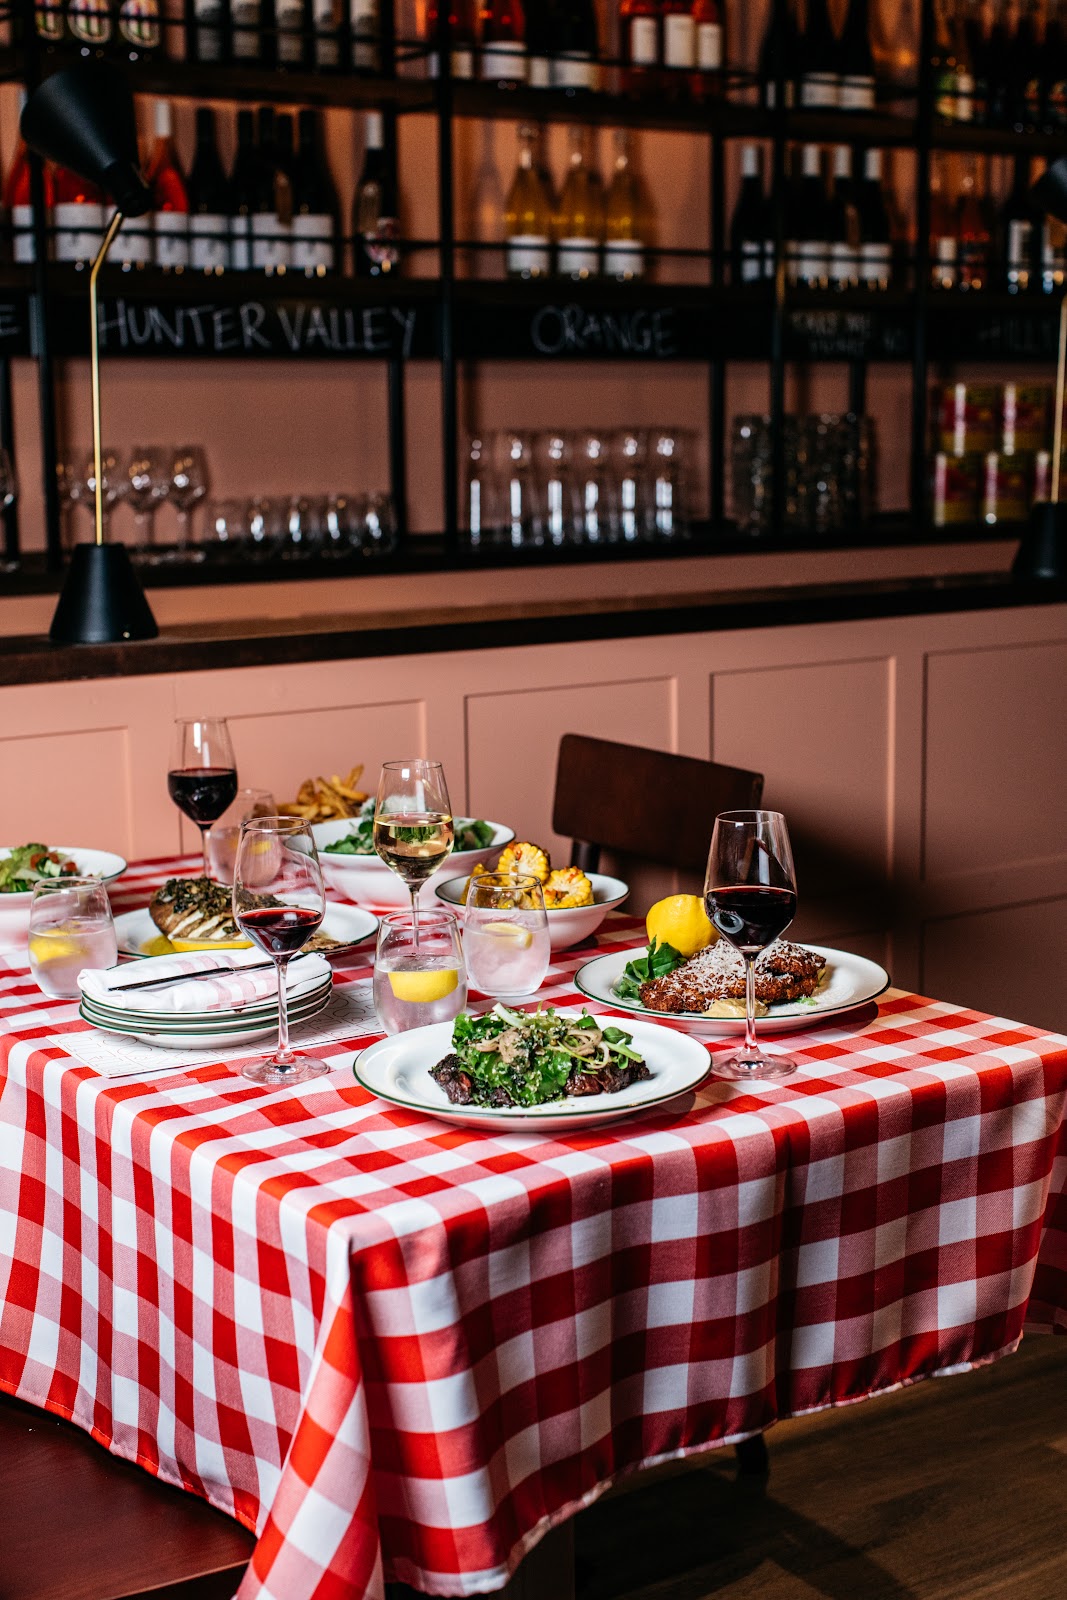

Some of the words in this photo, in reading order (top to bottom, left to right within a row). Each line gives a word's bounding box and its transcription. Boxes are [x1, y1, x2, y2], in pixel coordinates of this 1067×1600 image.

[99, 299, 274, 350] HUNTER
[279, 305, 415, 358] VALLEY
[533, 305, 675, 356] ORANGE
